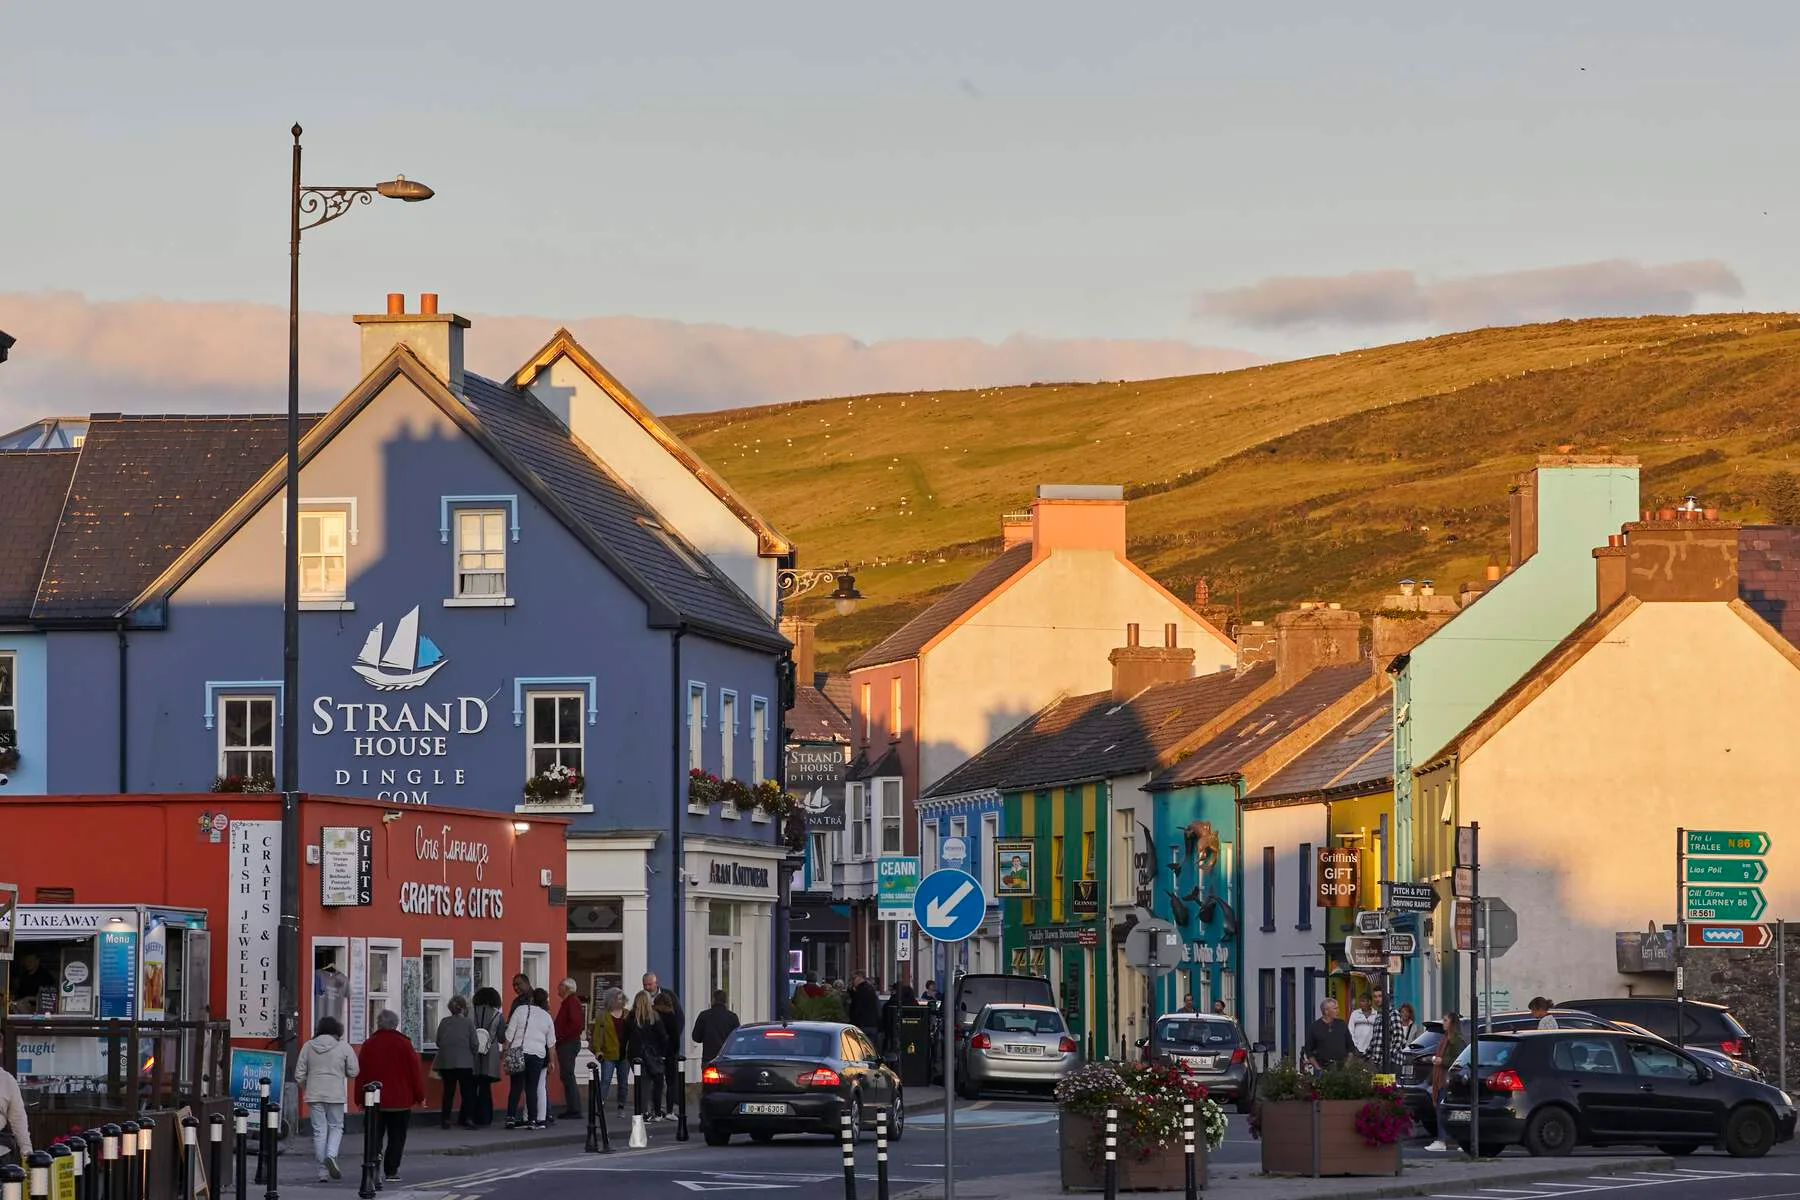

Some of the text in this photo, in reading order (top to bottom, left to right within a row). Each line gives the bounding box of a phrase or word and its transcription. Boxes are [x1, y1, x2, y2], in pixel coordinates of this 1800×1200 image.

[312, 696, 488, 735] STRAND
[353, 737, 447, 756] HOUSE
[791, 751, 843, 764] STRAND
[800, 764, 834, 772] HOUSE
[335, 769, 465, 785] DINGLE
[1690, 843, 1721, 851] TRALEE
[1728, 838, 1735, 847] N
[1737, 839, 1751, 848] 86
[1320, 853, 1358, 863] Griffin's
[360, 829, 371, 904] GIFTS
[881, 862, 916, 876] CEANN
[1324, 867, 1353, 879] GIFT
[1743, 871, 1749, 879] 9
[1320, 884, 1356, 895] SHOP
[1393, 887, 1410, 895] PITCH
[1416, 888, 1431, 896] PUTT
[400, 881, 503, 919] CRAFTS & GIFTS
[1391, 900, 1431, 909] DRIVING RANGE
[239, 830, 250, 1027] IRISH JEWELLERY
[259, 836, 272, 1021] CRAFTS & GIFTS
[901, 925, 908, 938] P
[106, 934, 130, 944] Menu
[243, 1064, 272, 1078] Anchor
[243, 1079, 261, 1091] DOW
